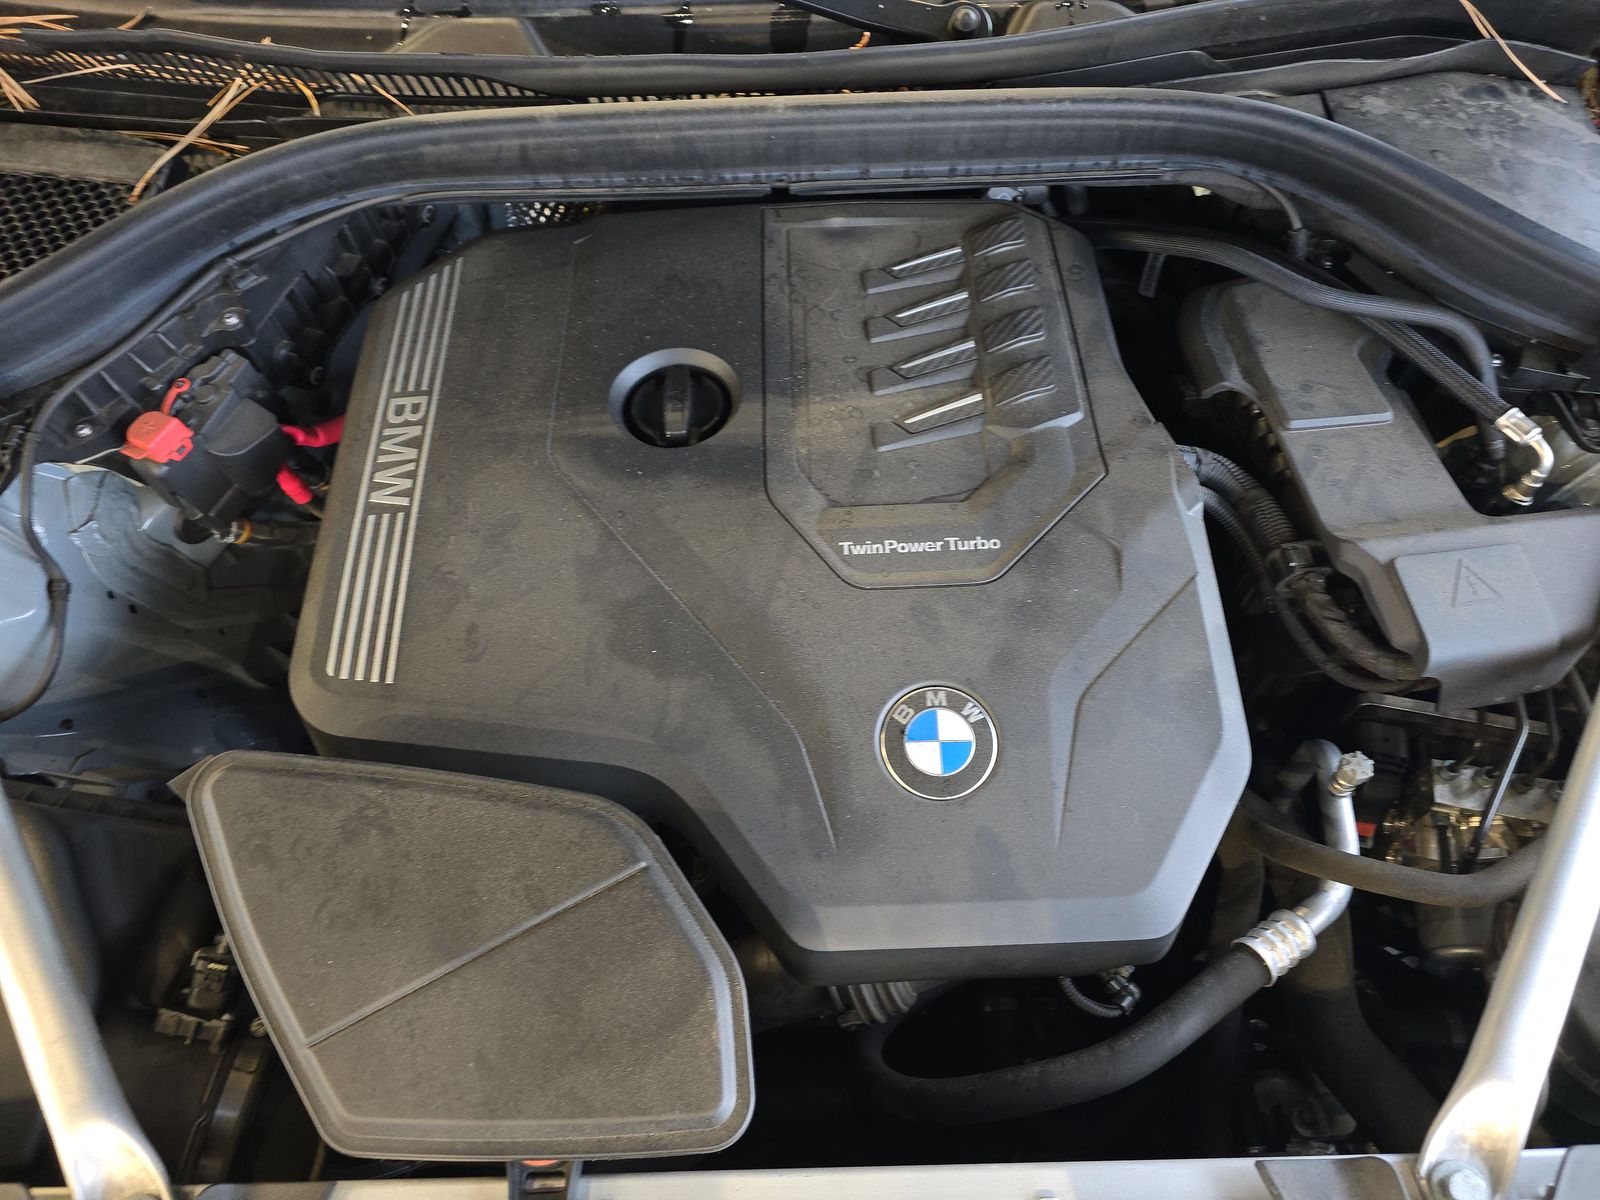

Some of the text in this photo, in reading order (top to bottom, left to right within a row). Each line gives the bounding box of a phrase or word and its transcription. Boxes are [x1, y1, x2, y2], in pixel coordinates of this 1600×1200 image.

[368, 395, 430, 506] BMW
[838, 536, 1001, 556] TwinPower Turbo
[892, 690, 986, 725] BMW
